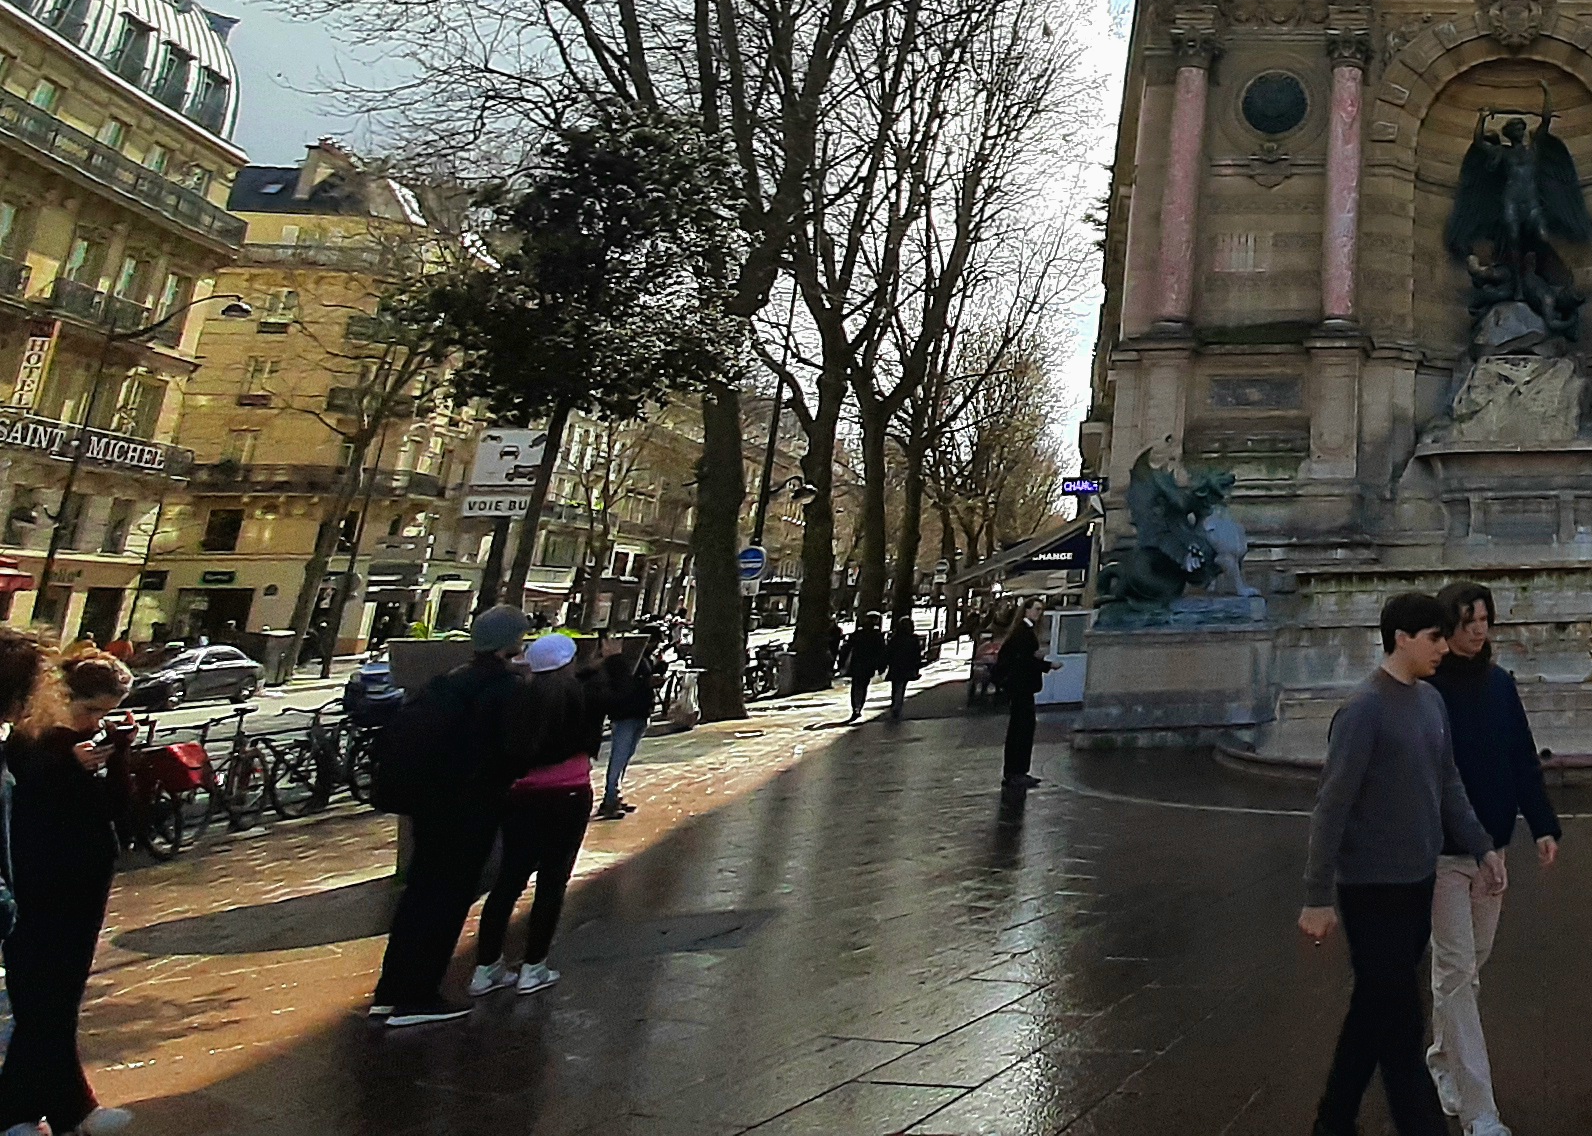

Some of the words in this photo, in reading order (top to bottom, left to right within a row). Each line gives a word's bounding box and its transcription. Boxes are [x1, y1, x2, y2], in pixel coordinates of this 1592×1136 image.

[16, 338, 47, 406] HOTEL
[85, 435, 165, 469] MICHEL
[468, 500, 503, 511] VOIE
[508, 499, 528, 512] BU
